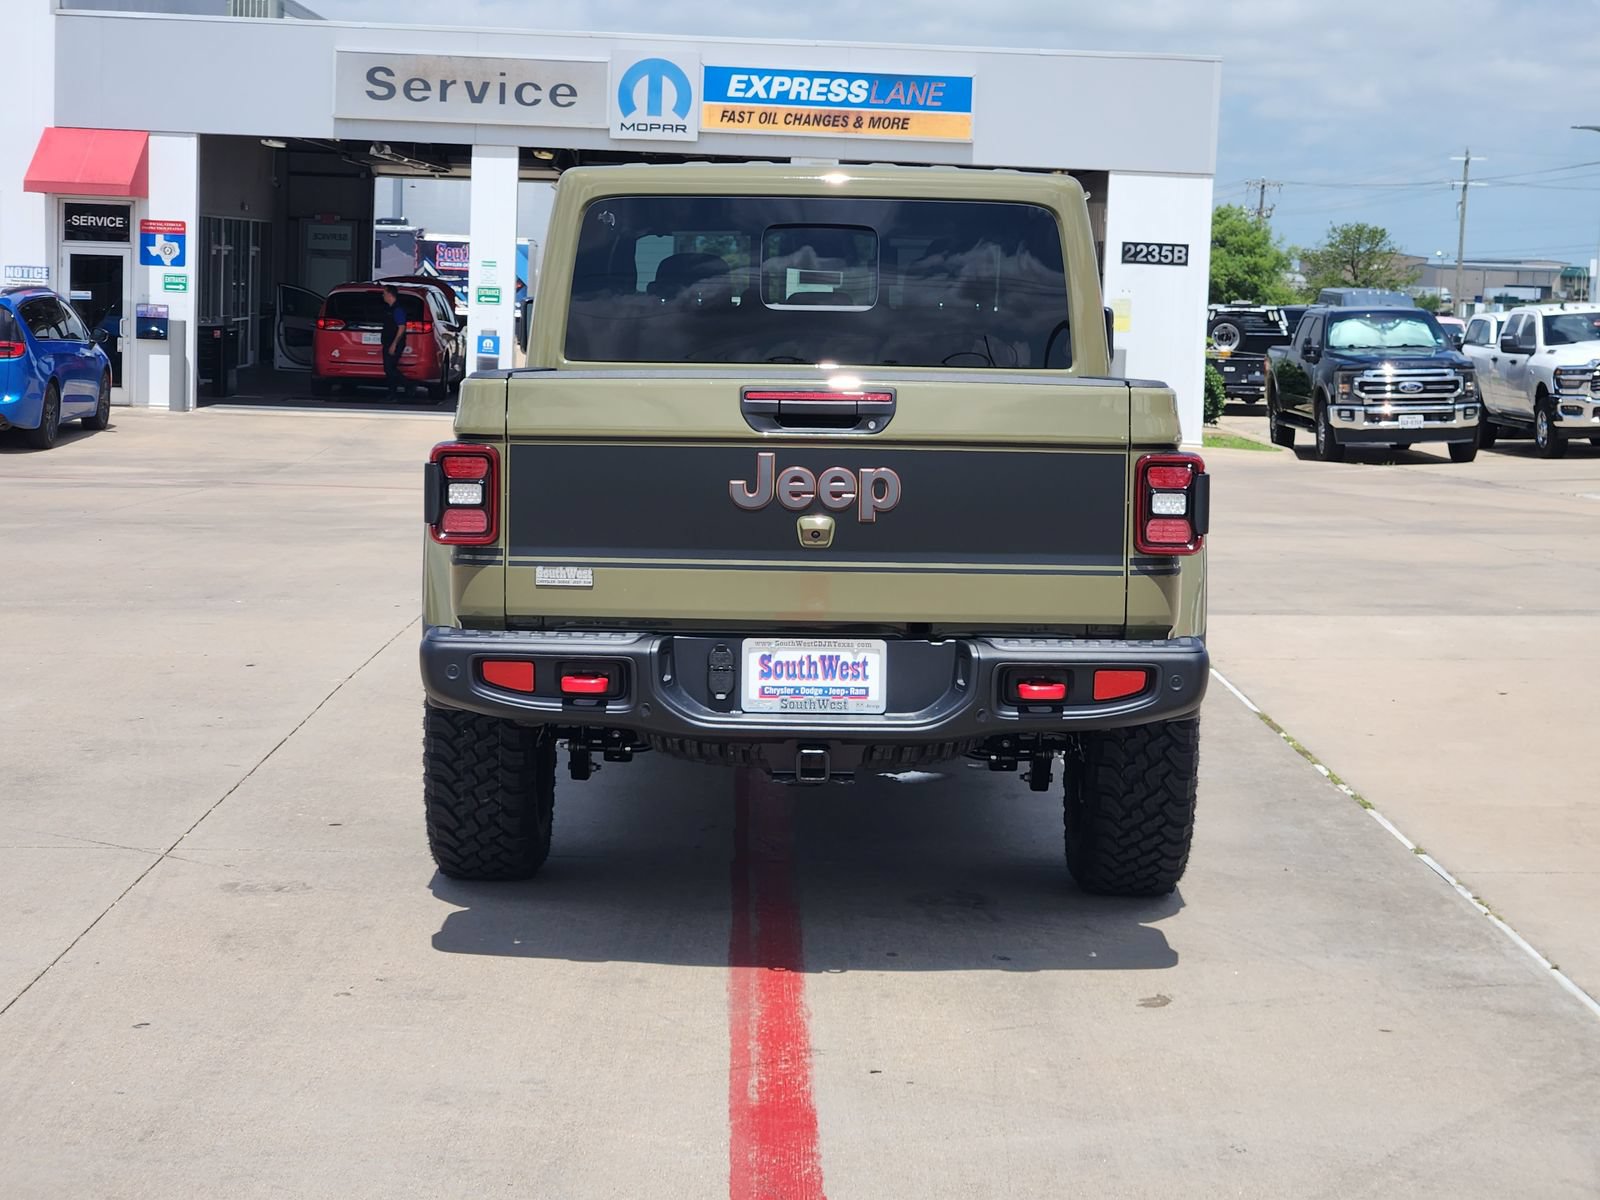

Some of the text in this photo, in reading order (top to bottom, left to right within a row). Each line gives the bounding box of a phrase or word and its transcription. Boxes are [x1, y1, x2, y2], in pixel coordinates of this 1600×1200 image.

[365, 66, 578, 108] Service
[720, 110, 910, 130] FAST OIL CHANGES & MORE
[620, 122, 688, 133] MOPAR
[71, 214, 124, 228] SERVICE
[1124, 244, 1187, 263] 2235B
[5, 266, 49, 279] NOTICE
[729, 452, 901, 523] Jeep
[536, 566, 592, 579] SouthWest
[759, 653, 870, 680] SouthWest
[764, 687, 866, 696] Chrysler Dodge Jeep Ram
[780, 699, 848, 710] SouthWest
